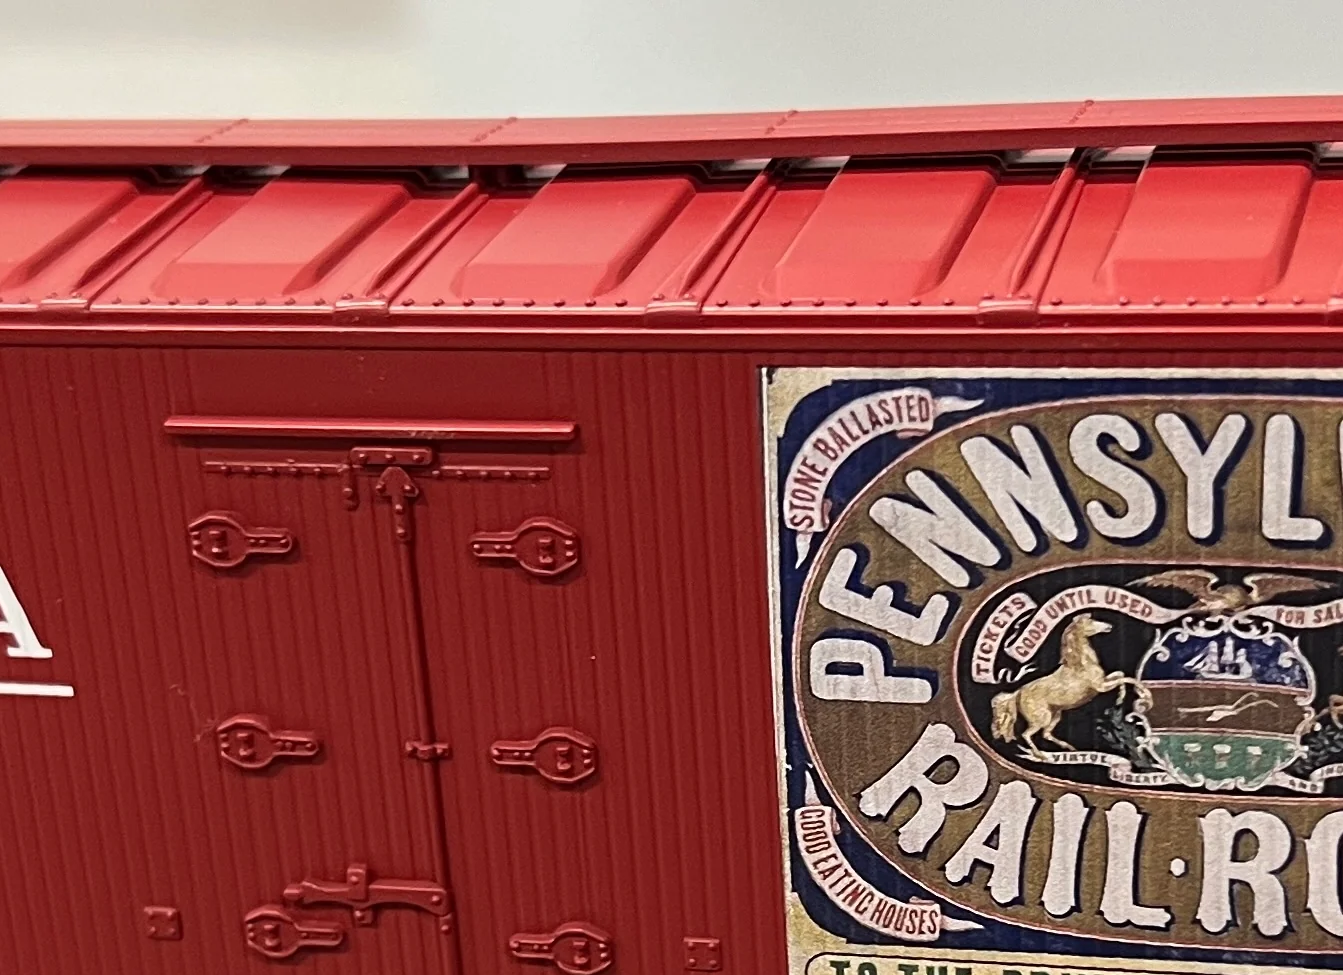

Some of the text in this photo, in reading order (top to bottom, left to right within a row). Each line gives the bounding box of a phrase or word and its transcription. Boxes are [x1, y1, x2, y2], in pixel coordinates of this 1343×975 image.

[789, 394, 930, 529] STONE BALLASTED
[975, 596, 1027, 677] TICKETS
[1015, 588, 1152, 658] GOOD UNTIL USED
[1276, 607, 1305, 625] FOR
[800, 808, 939, 935] GOOD EATING HOUSES
